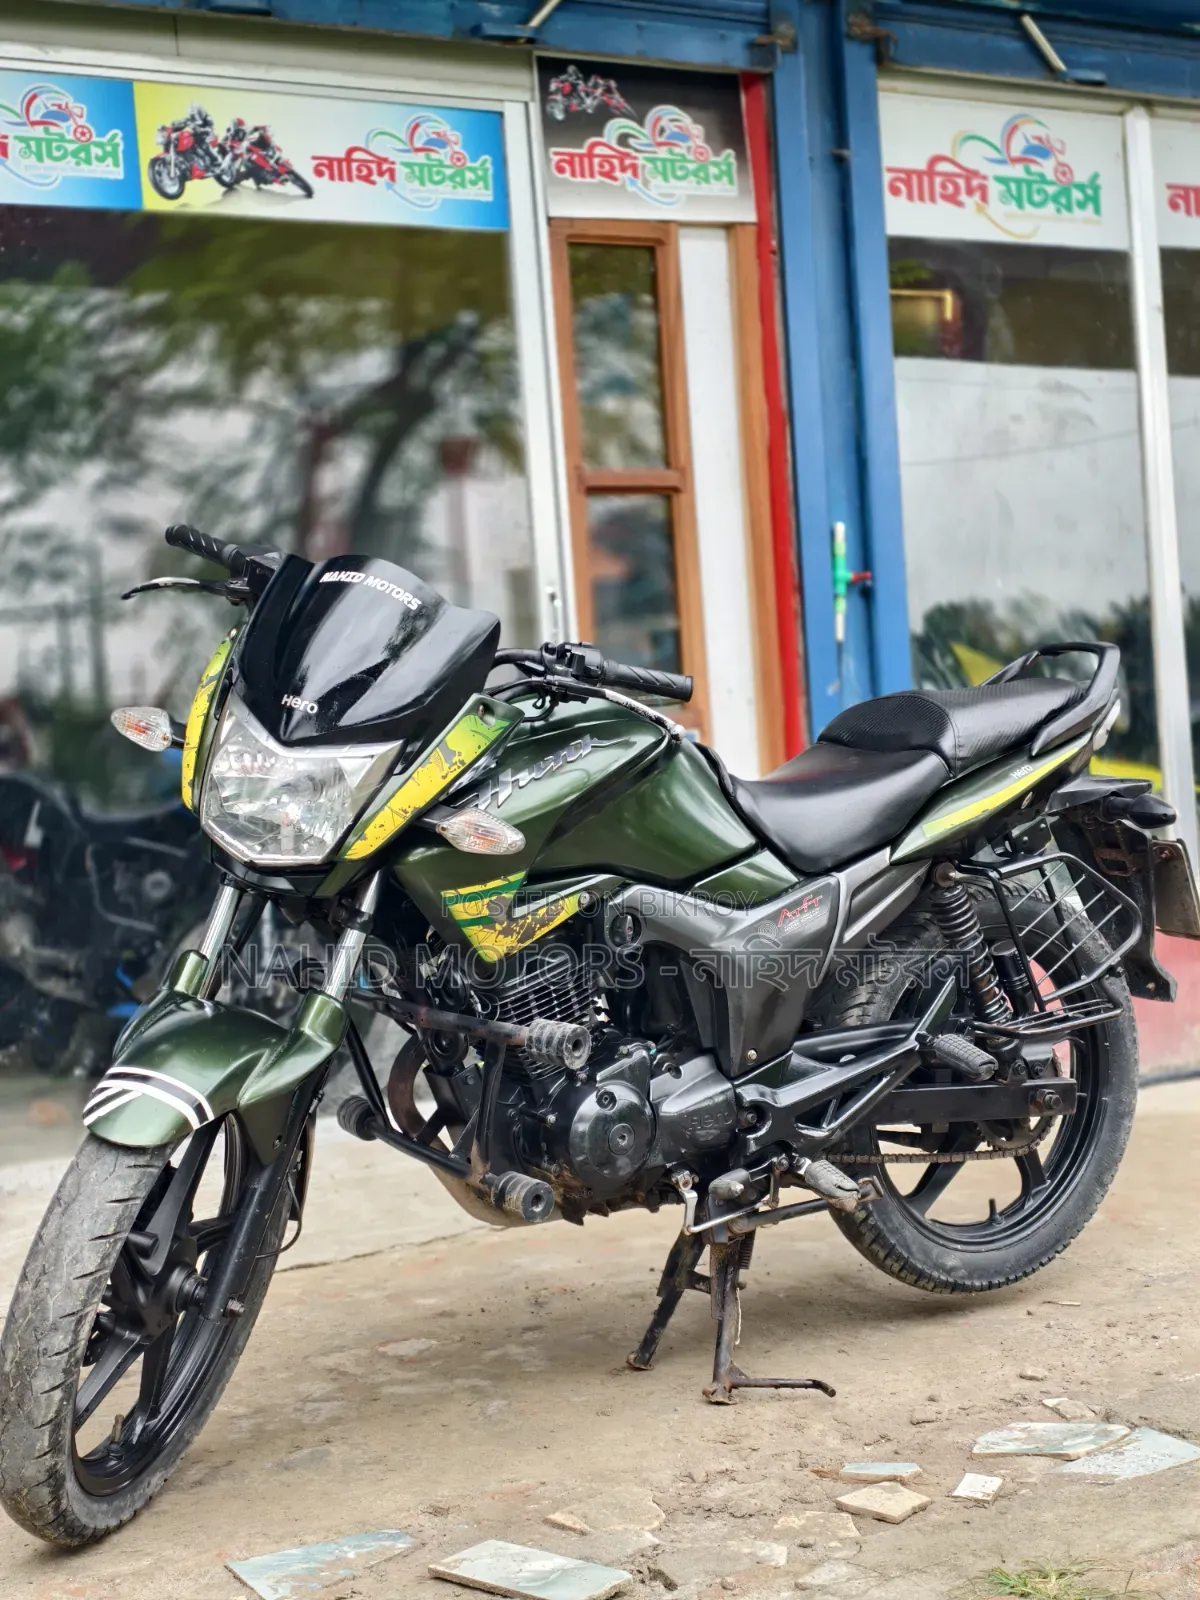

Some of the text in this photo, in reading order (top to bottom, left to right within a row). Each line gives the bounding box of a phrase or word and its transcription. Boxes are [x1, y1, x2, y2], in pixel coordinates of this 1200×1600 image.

[311, 146, 396, 186] নাহিদ
[552, 139, 640, 182] নাহিদ
[886, 154, 989, 208] নাহিদ
[319, 571, 422, 611] NAHID MOTORS
[281, 694, 318, 714] Hero
[1010, 764, 1033, 779] Hero
